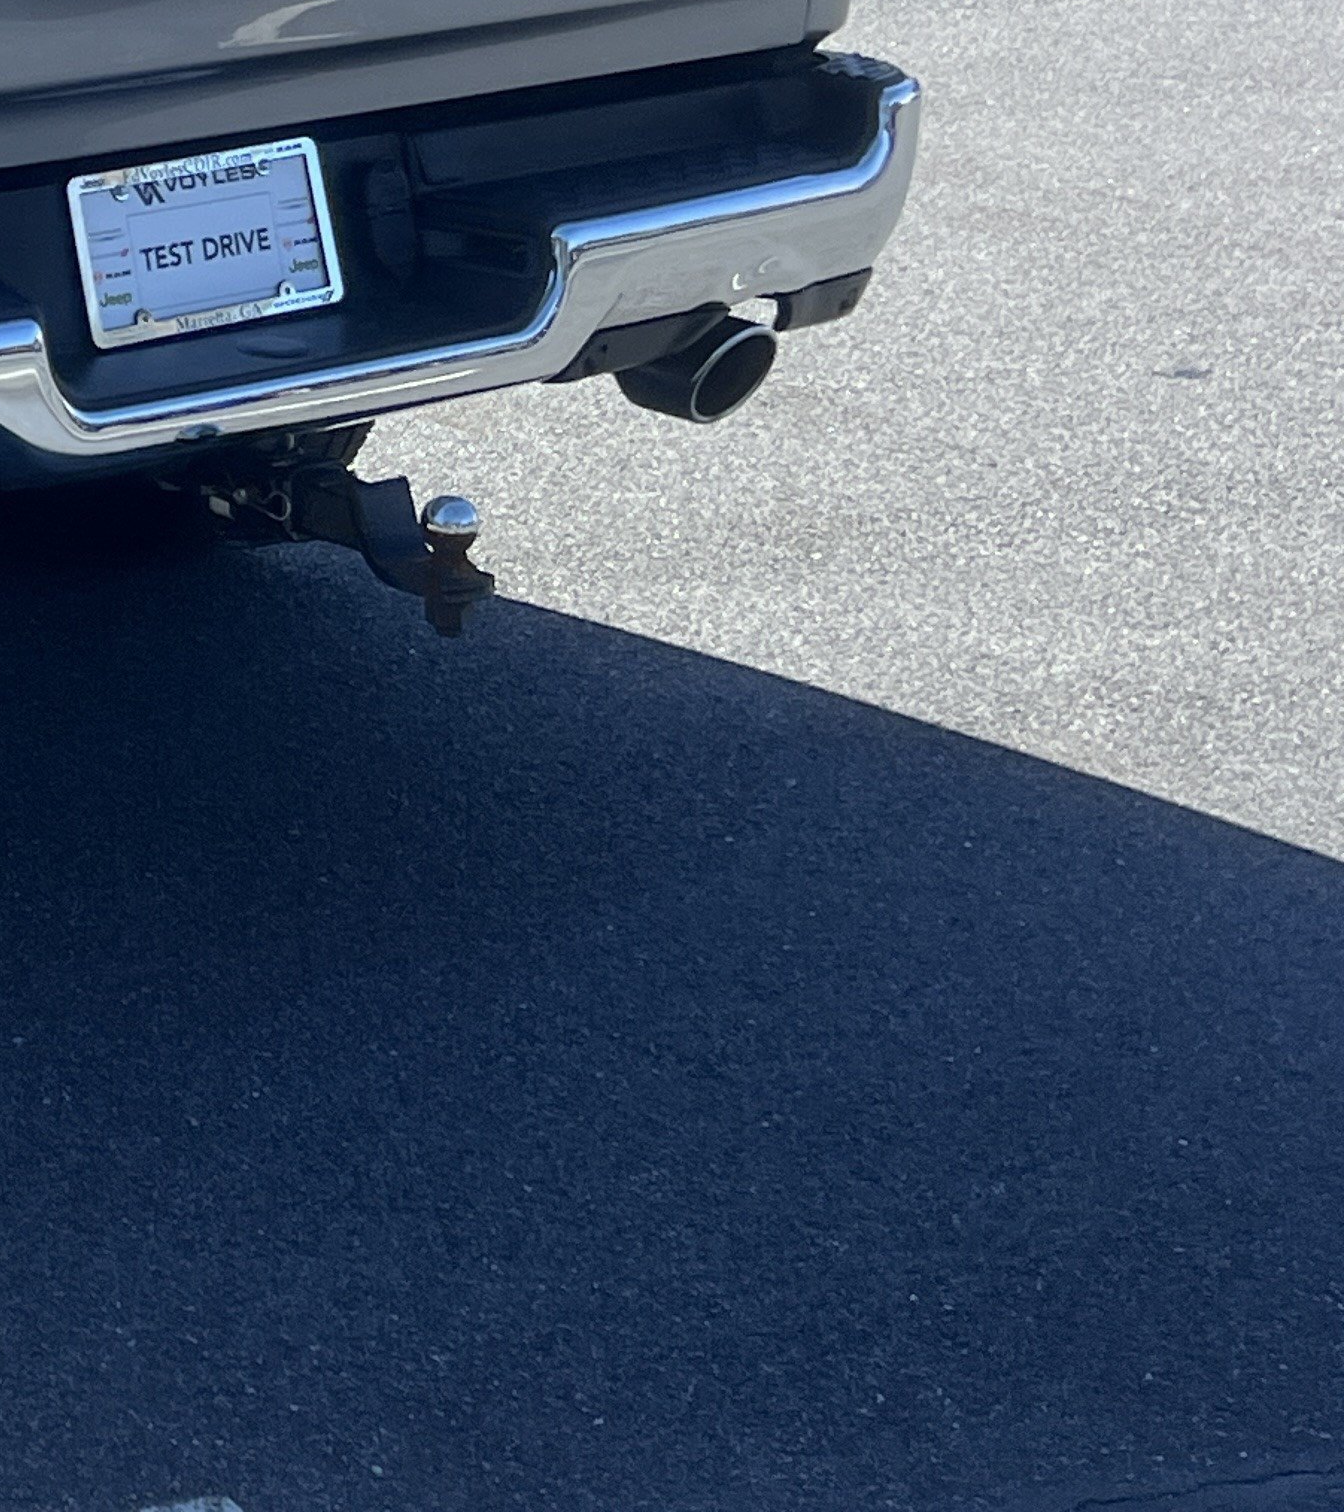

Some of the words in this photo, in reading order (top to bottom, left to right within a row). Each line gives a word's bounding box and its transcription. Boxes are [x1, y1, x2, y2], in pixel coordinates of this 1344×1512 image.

[163, 164, 256, 193] VOYLES
[139, 239, 194, 272] TEST
[201, 227, 272, 262] DRIVE
[288, 257, 319, 274] Jeep
[99, 291, 133, 309] Jeep
